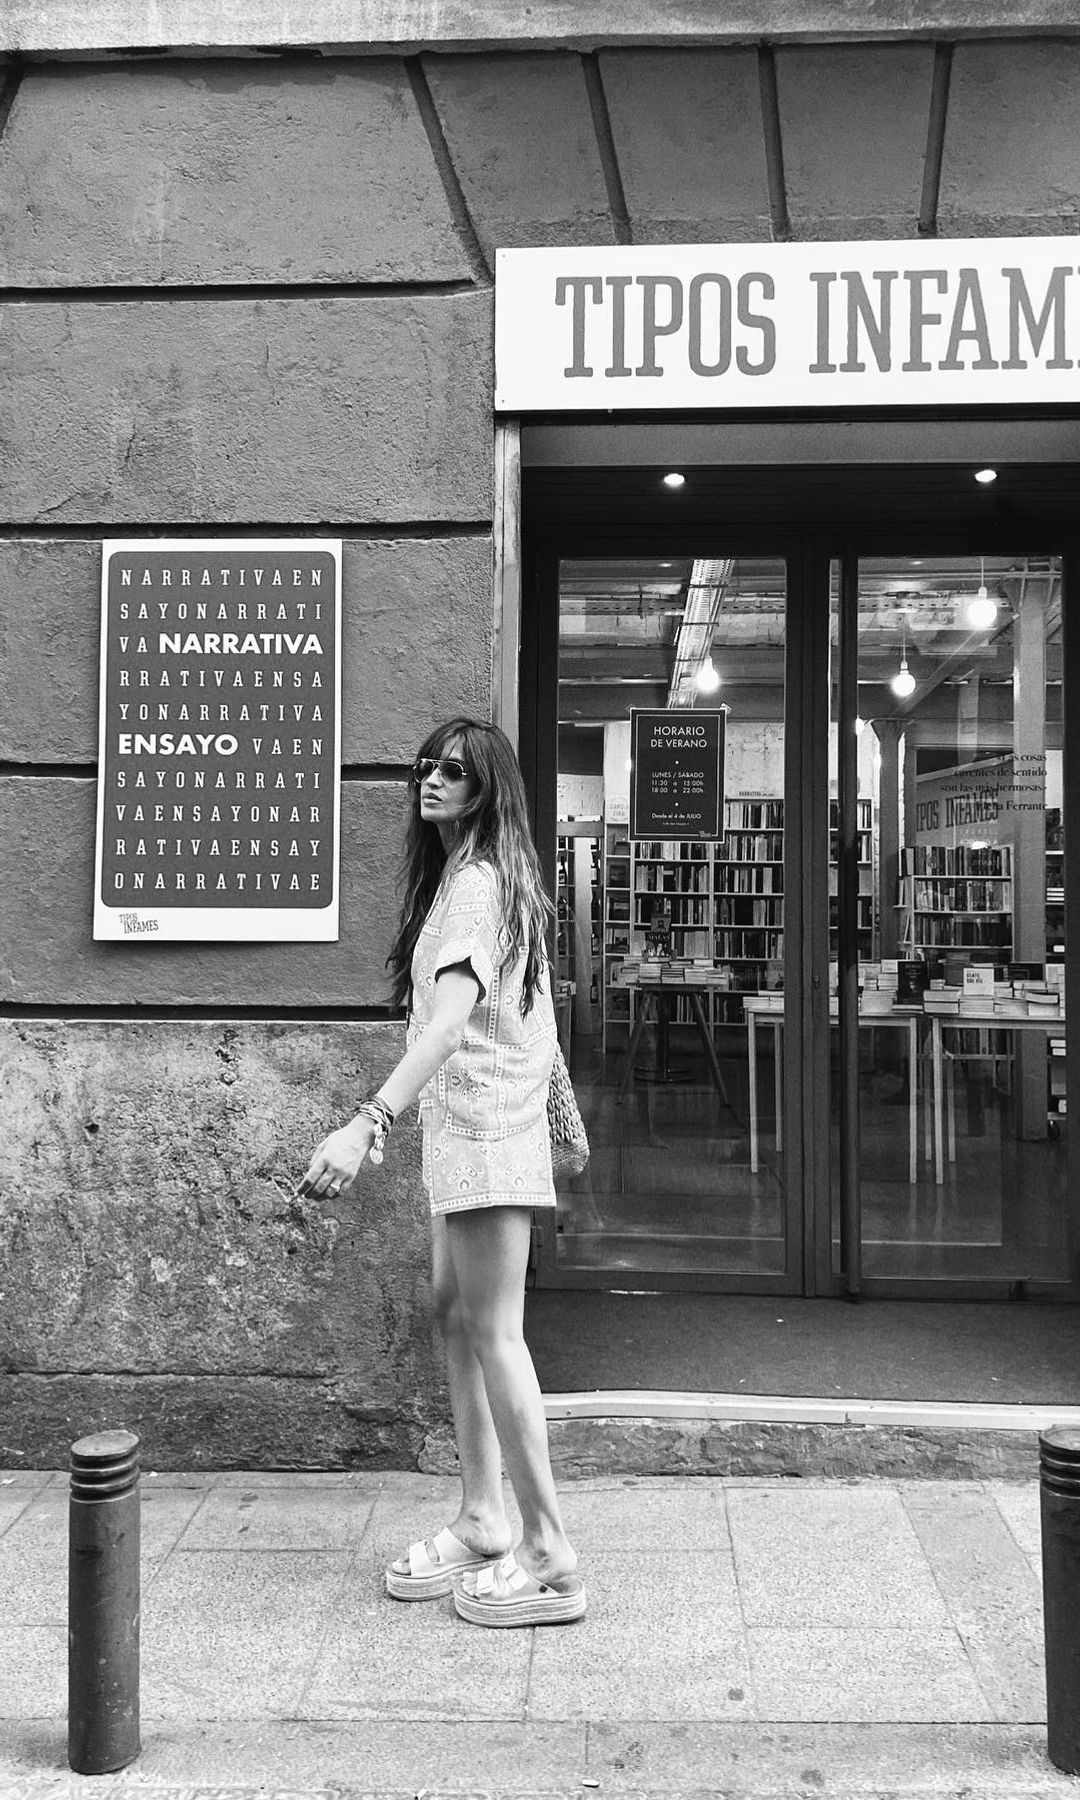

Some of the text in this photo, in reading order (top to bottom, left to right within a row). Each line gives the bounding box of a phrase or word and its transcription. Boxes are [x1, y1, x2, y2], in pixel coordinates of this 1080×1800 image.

[555, 265, 1080, 379] TIPOS INFAM
[121, 569, 322, 586] NARRATIVAEN
[121, 602, 321, 620] SAYONARRATI
[119, 633, 324, 655] VA NARRATIVA
[120, 670, 322, 688] RRATIVAENSA
[119, 704, 323, 721] YONARRATIVA
[653, 726, 705, 736] HORARIO
[118, 734, 323, 756] ENSAYO VAEN
[650, 738, 708, 748] DE VERANO
[117, 771, 320, 789] SAYONARRATI
[1011, 767, 1048, 777] sentido
[115, 804, 320, 822] VAENSAYONAR
[916, 800, 940, 833] IPOS
[116, 838, 320, 857] RATIVAENSAY
[114, 872, 320, 890] ONARRATIVAE
[119, 912, 139, 924] TIPOS
[123, 919, 159, 935] INFAMES
